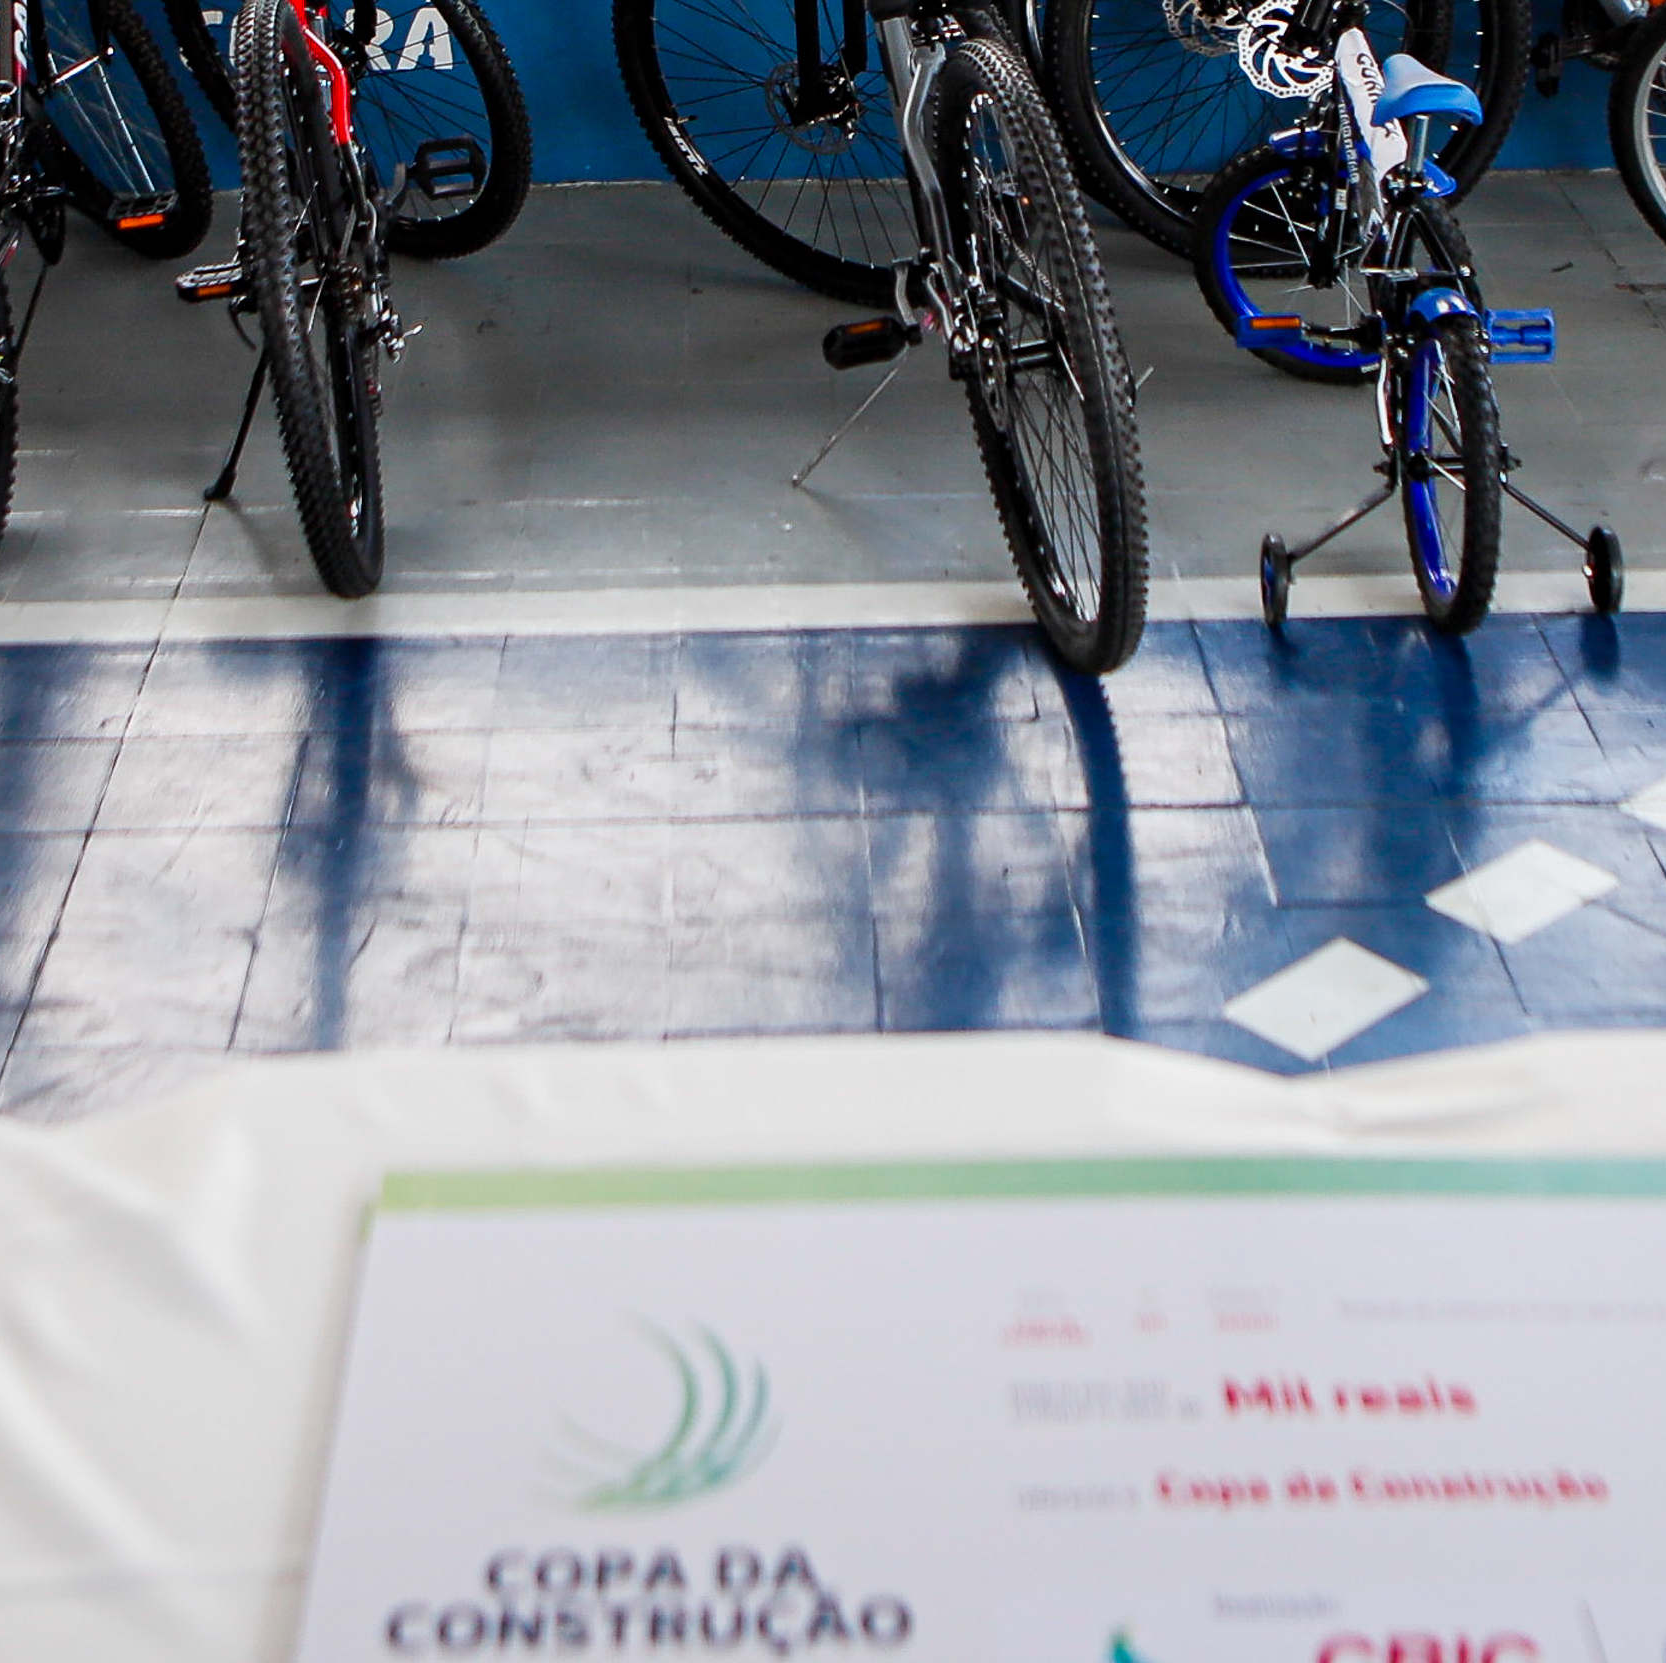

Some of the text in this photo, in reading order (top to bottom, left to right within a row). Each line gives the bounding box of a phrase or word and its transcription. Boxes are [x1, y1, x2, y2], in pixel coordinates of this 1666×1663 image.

[1219, 1371, 1319, 1417] Mil
[1332, 1373, 1478, 1416] reais
[1153, 1467, 1271, 1513] Copa
[1345, 1466, 1612, 1511] Construção
[483, 1544, 819, 1594] COPA DA
[384, 1586, 915, 1659] CONSTRUÇÃO
